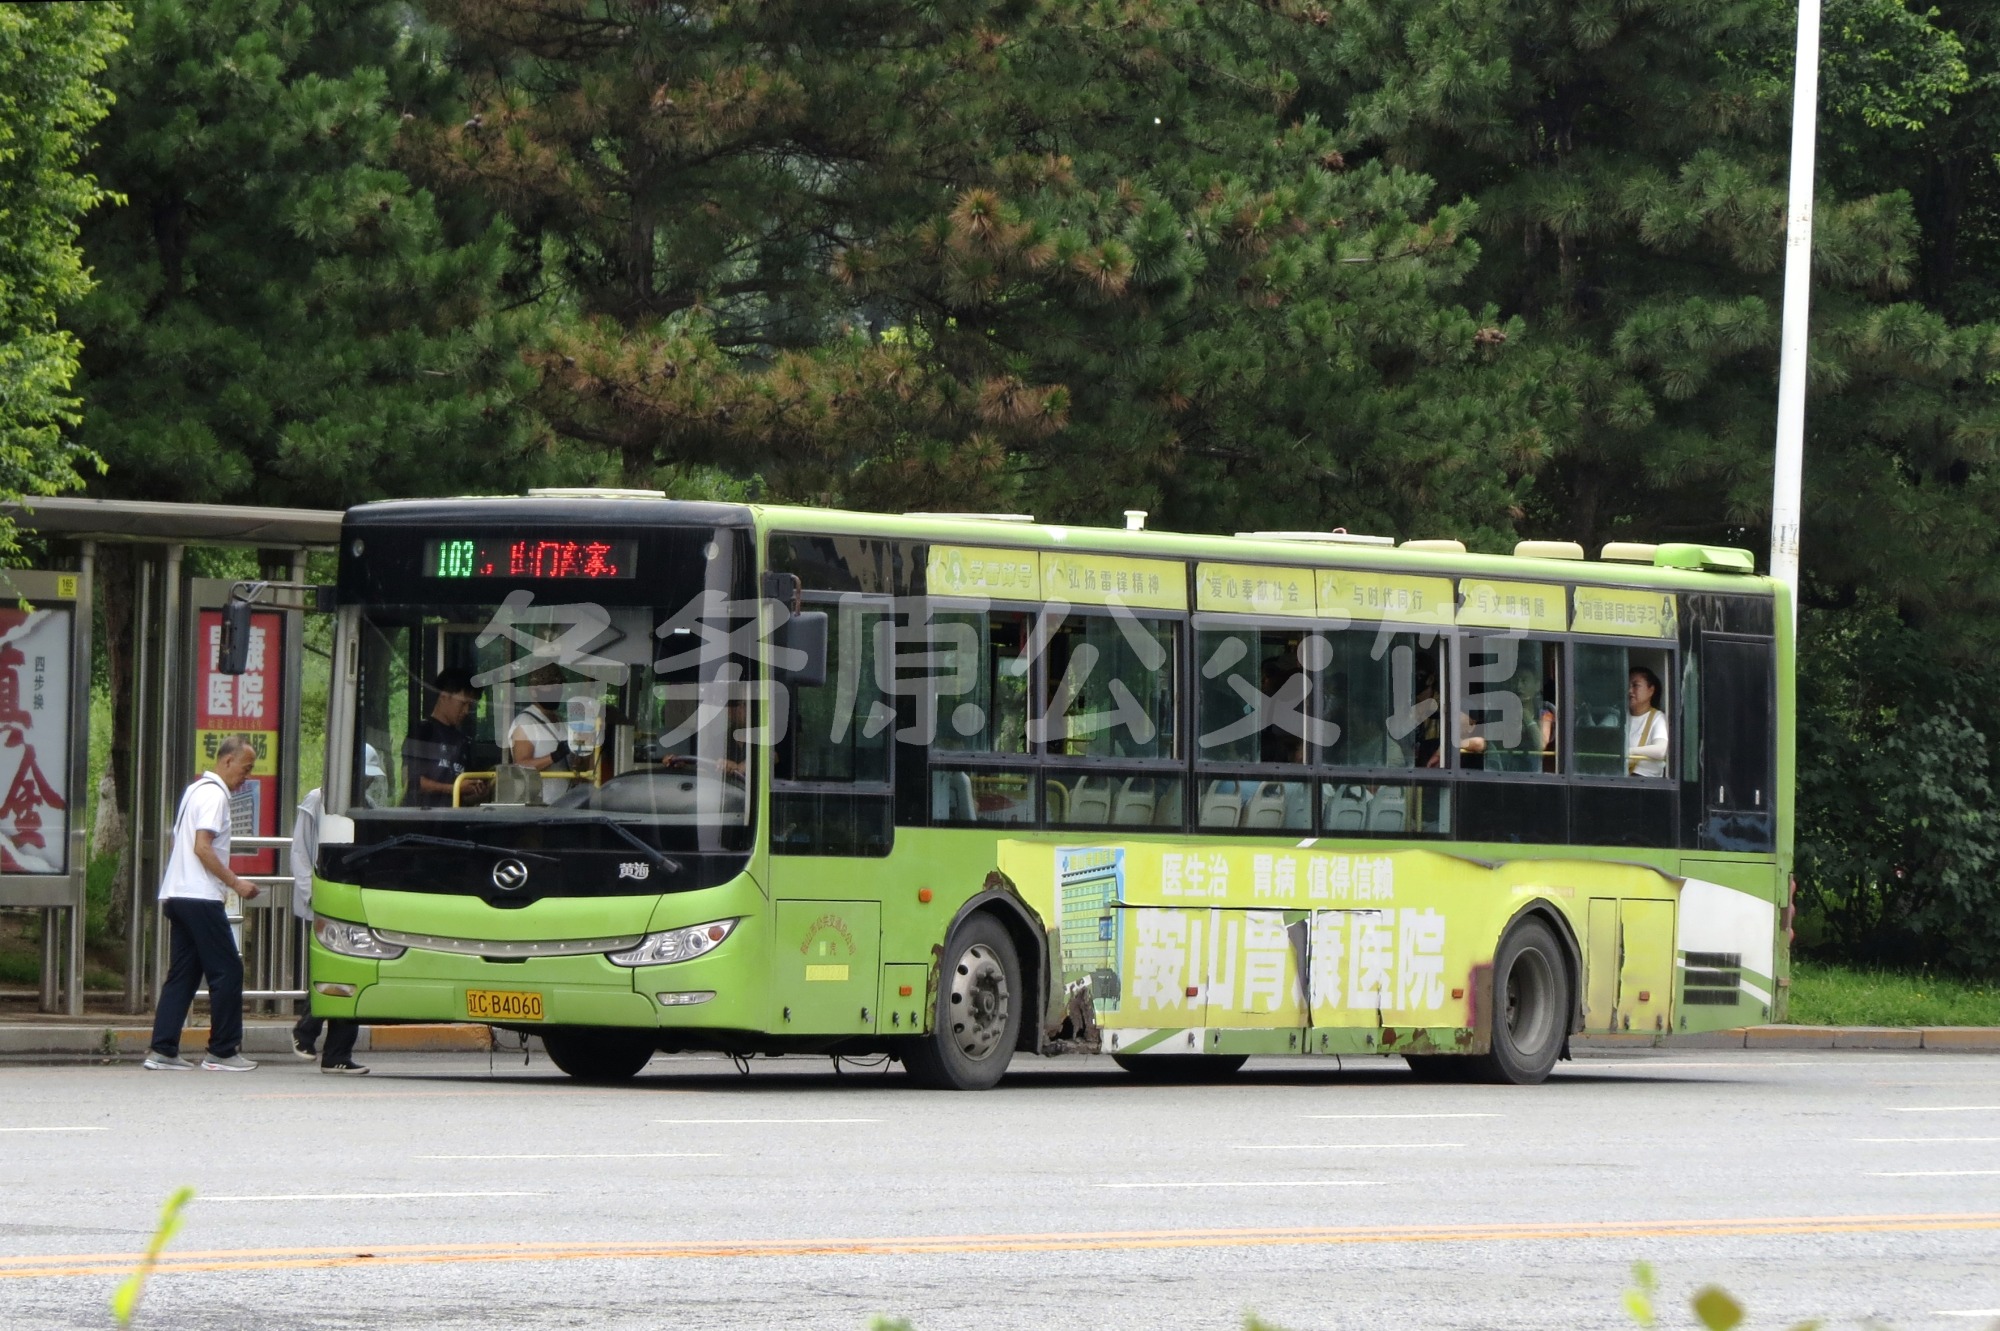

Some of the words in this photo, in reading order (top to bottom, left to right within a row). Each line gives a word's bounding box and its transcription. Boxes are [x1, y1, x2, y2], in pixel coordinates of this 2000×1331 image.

[439, 541, 475, 577] 103
[969, 560, 1032, 588] 学雷锋号
[1068, 568, 1160, 594] 弘扬雷锋精神
[1211, 576, 1298, 602] 爱心奉献社会
[1353, 585, 1422, 610] 与时代同行
[1477, 594, 1545, 618] 与文明相随
[1582, 599, 1658, 625] 向雷锋同志学习
[33, 656, 46, 710] 四步换
[208, 673, 264, 717] 医院
[619, 862, 649, 879] 黄海
[1162, 854, 1229, 897] 医生治
[1253, 854, 1297, 898] 胃病
[1307, 855, 1394, 900] 值得信赖
[1132, 905, 1445, 1011] 鞍山胃康医院
